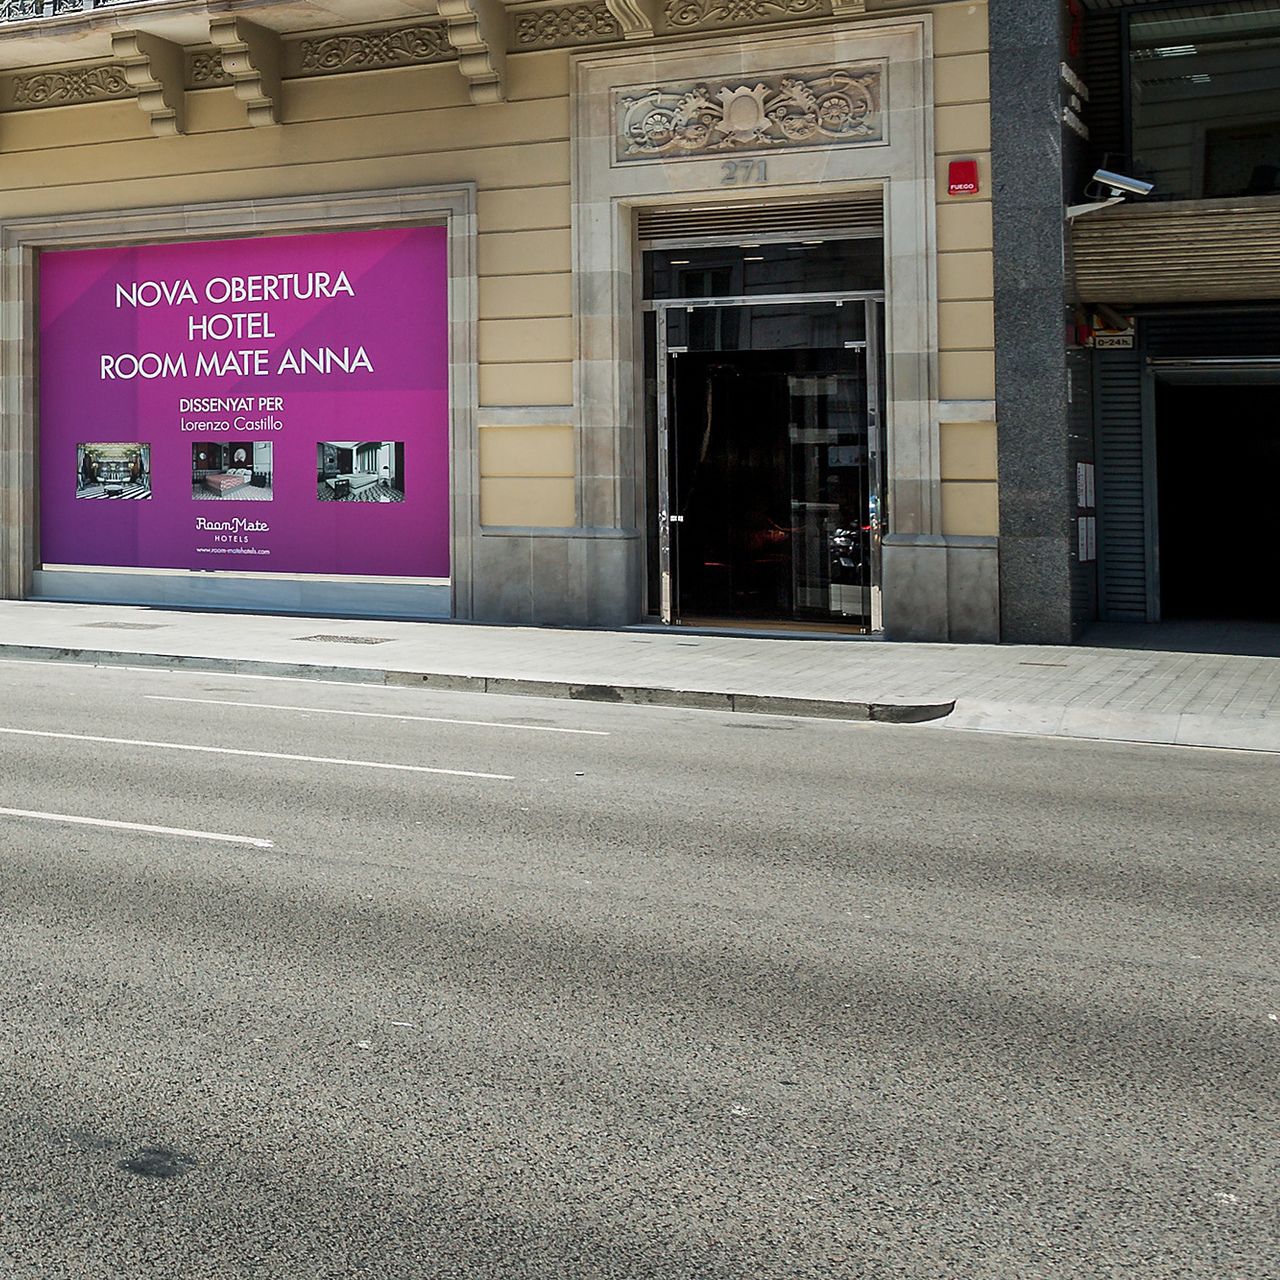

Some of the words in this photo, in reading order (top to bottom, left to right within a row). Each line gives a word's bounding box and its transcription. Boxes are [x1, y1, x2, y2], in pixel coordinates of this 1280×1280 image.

[720, 159, 768, 184] 271
[115, 279, 199, 308] NOVA
[205, 270, 355, 304] OBERTURA
[188, 312, 275, 341] HOTEL
[100, 352, 187, 380] ROOM
[194, 349, 269, 377] MATE
[277, 346, 374, 375] ANNA
[179, 396, 255, 413] DISSENYAT
[258, 396, 284, 411] PER
[181, 417, 230, 432] Lorenzo
[233, 415, 283, 431] Castillo
[214, 534, 249, 543] HOTELS
